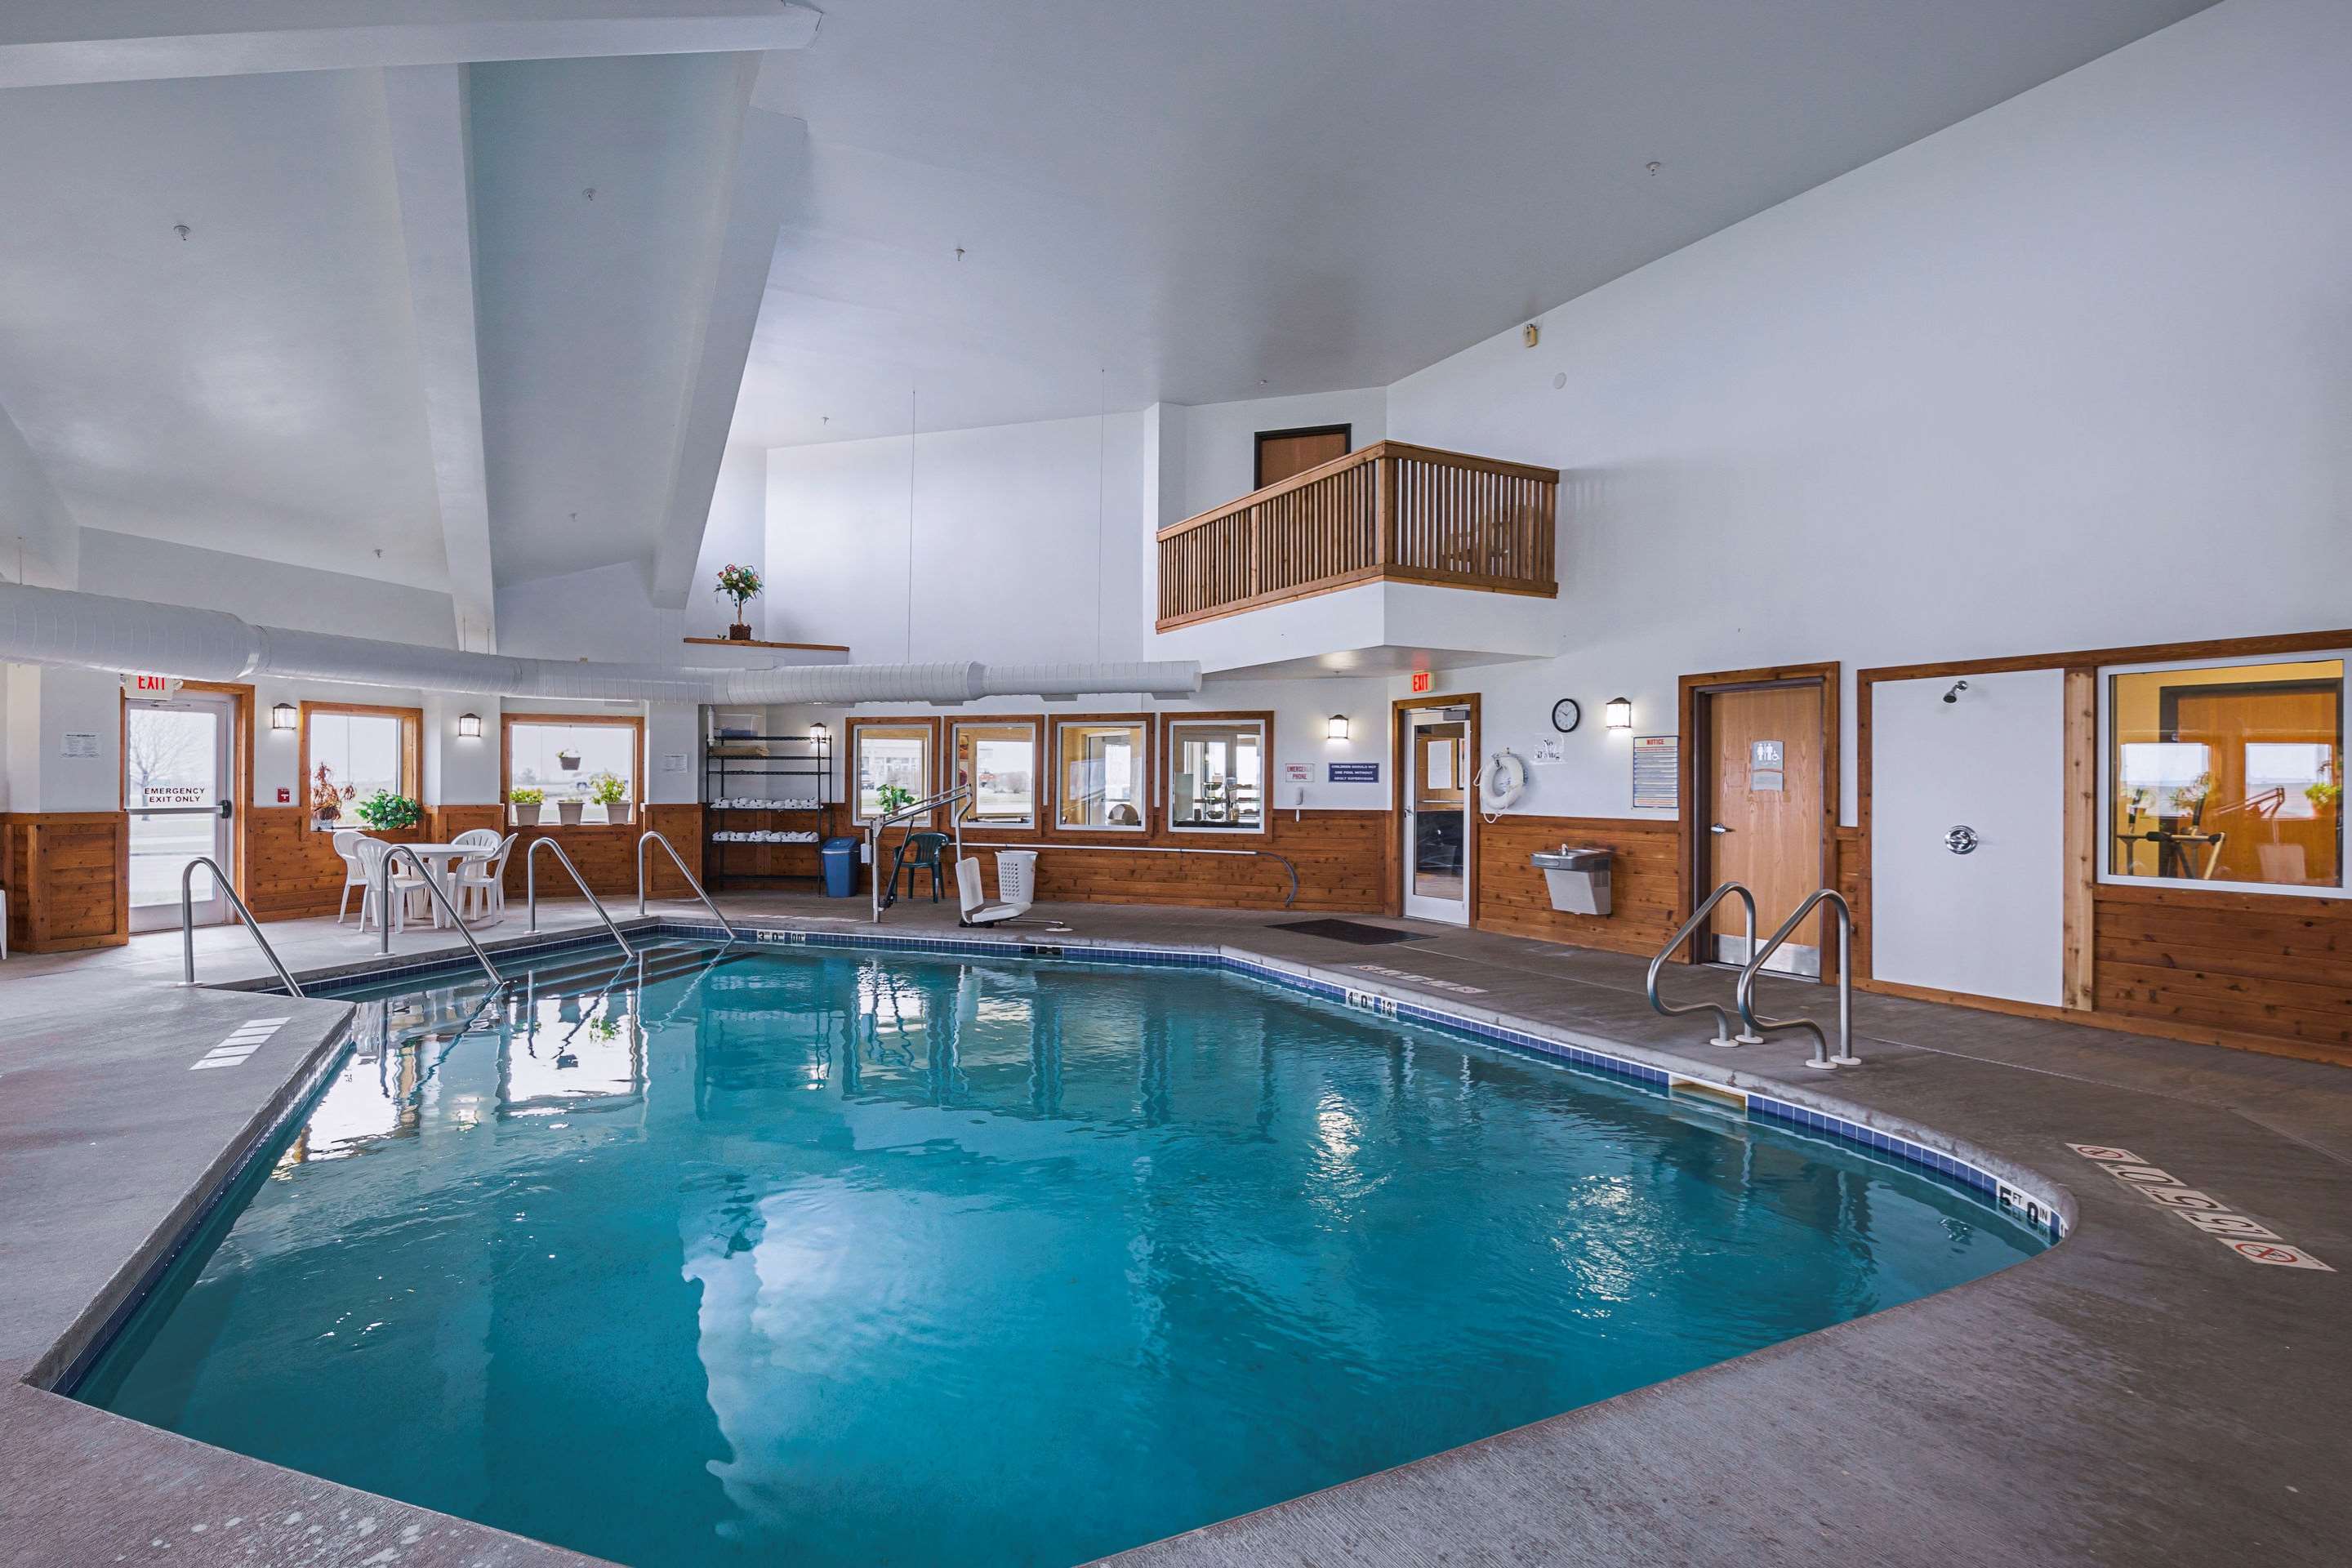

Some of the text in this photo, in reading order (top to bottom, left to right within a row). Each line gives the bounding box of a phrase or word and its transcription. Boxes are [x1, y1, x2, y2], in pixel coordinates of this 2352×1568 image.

[138, 675, 165, 690] EXIT
[1413, 672, 1429, 692] EXIT
[1999, 1185, 2012, 1205] 5
[2012, 1192, 2023, 1205] FT
[2027, 1201, 2039, 1223] 0
